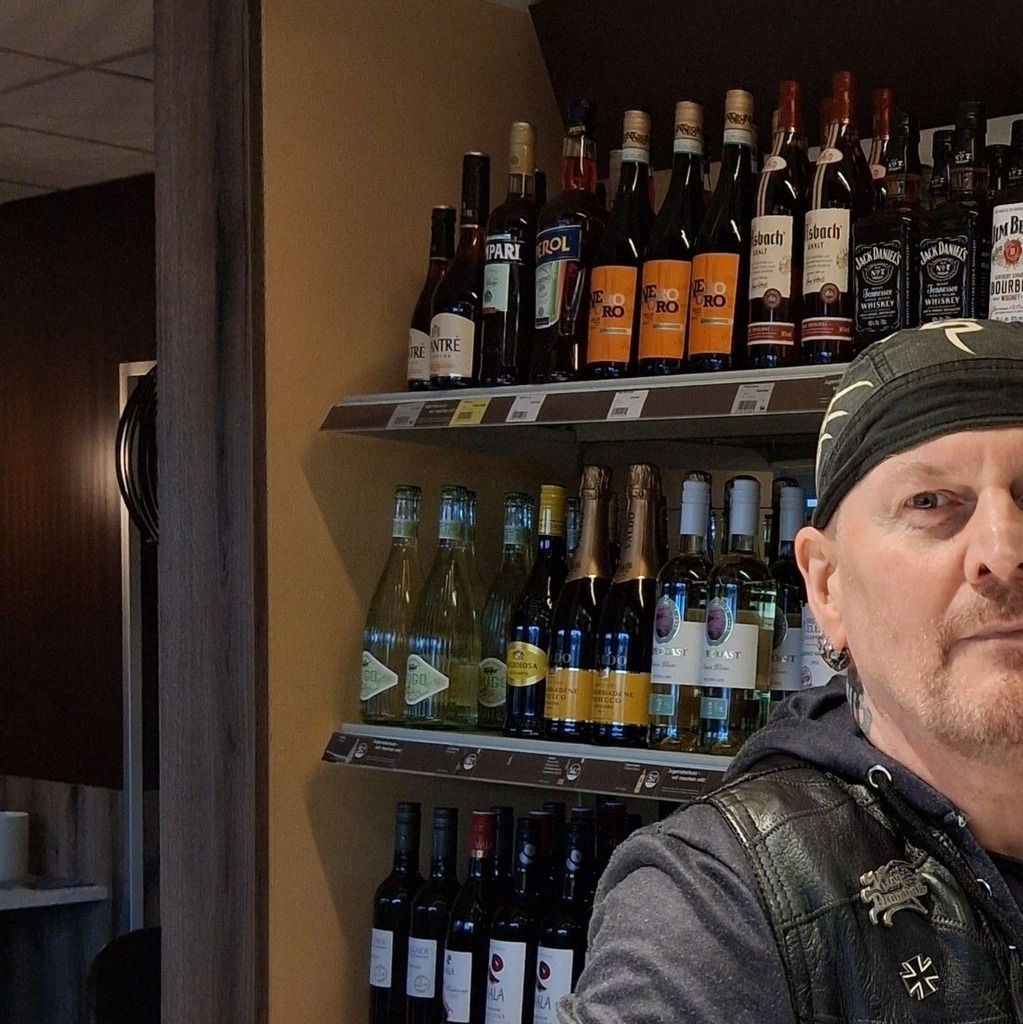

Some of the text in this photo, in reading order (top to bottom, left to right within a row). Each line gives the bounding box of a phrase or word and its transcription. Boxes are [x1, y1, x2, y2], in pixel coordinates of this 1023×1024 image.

[855, 246, 902, 271] JACK DANIEL'S
[920, 241, 969, 266] JACK DANIEL'S
[862, 288, 893, 299] Tennessee
[926, 284, 959, 294] Tennessee
[860, 300, 895, 311] WHISKEY
[924, 296, 961, 307] WHISKEY
